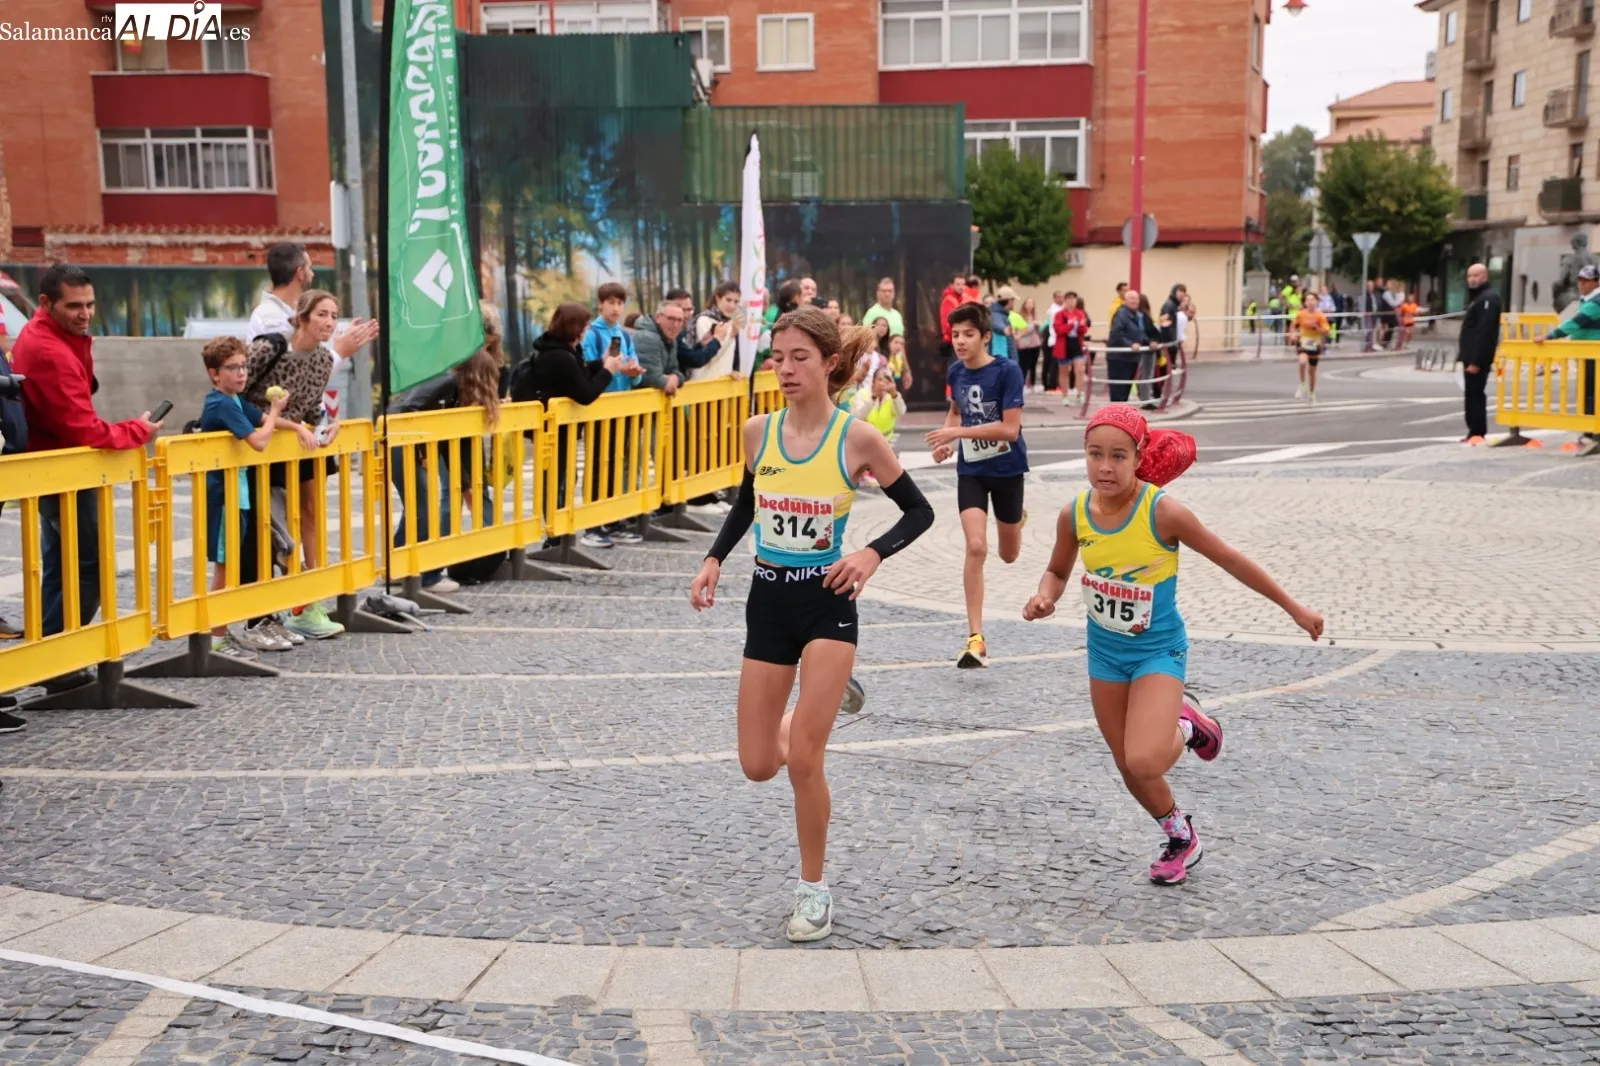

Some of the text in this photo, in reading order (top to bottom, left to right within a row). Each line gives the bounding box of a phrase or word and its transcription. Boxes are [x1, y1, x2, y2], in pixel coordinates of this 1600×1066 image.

[758, 494, 832, 515] bedunia
[772, 514, 818, 539] 314
[755, 565, 777, 581] RO
[1081, 573, 1153, 602] bedunia
[1093, 593, 1135, 622] 315
